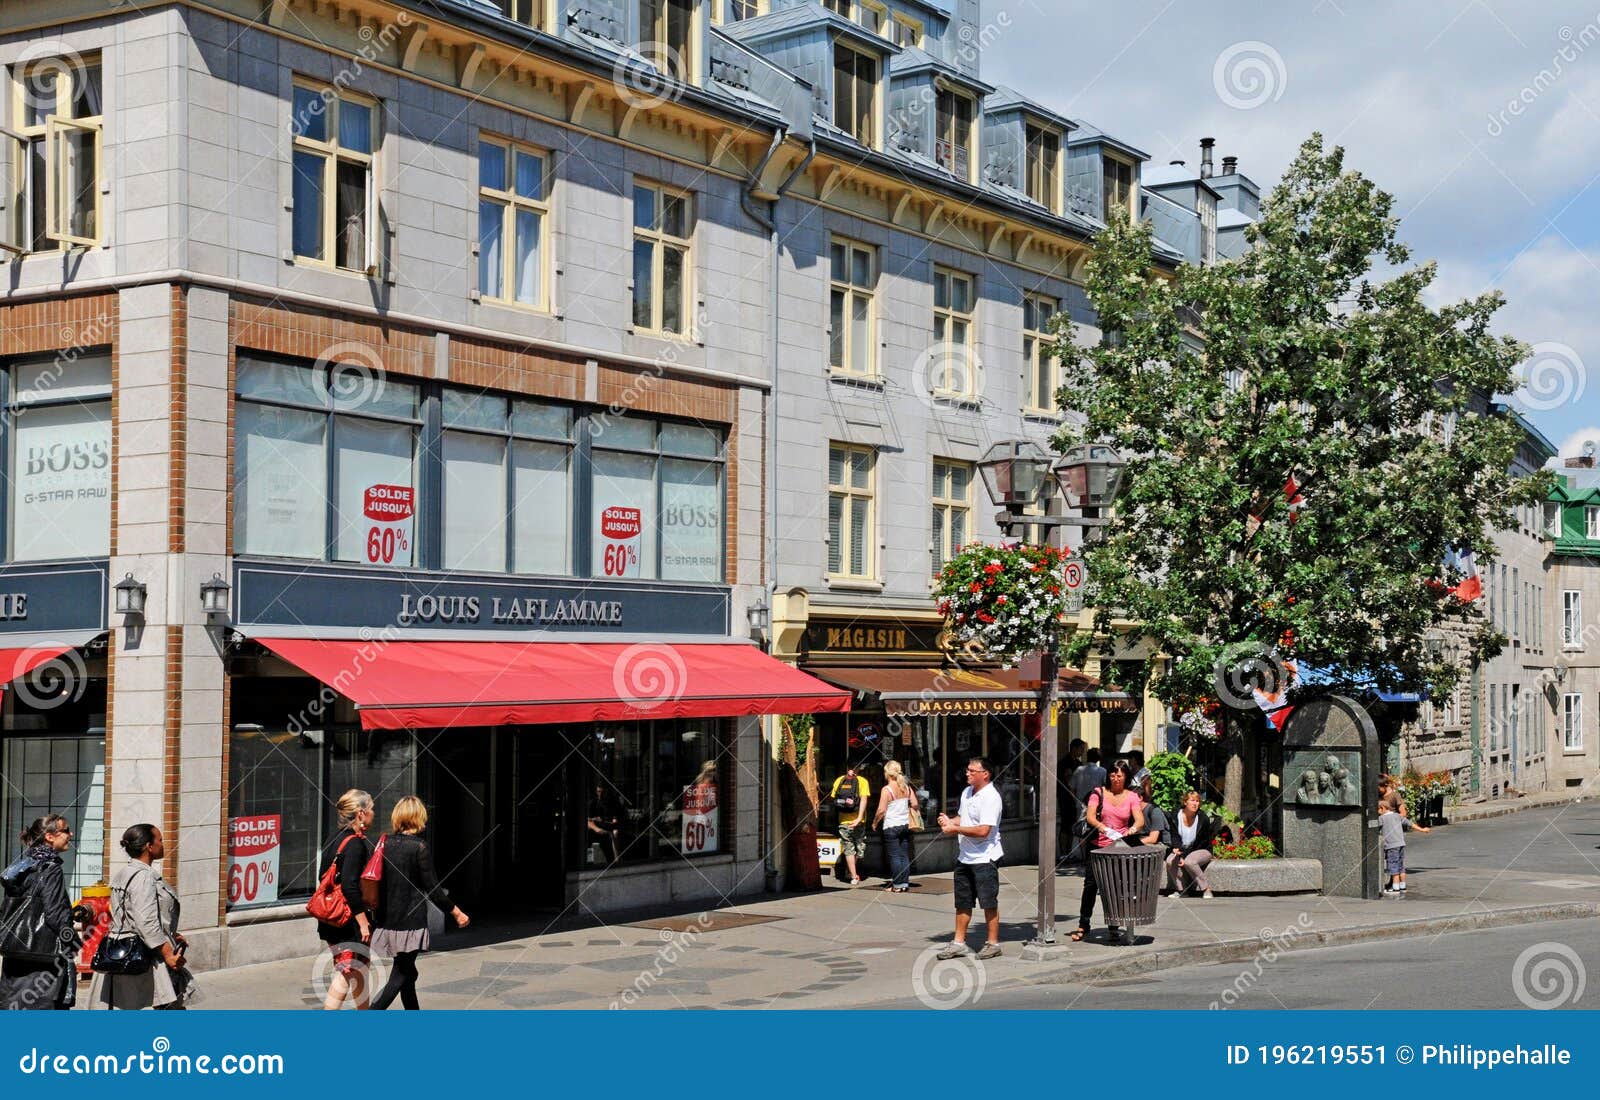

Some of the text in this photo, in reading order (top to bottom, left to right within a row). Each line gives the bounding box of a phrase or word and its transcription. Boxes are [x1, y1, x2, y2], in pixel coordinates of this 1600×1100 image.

[25, 440, 108, 476] BOSS
[24, 488, 107, 504] G-STAR RAW
[368, 487, 410, 500] SOLDE
[368, 501, 412, 515] JUSQU'À
[605, 509, 638, 520] SOLDE
[664, 503, 718, 529] BOSS
[605, 521, 639, 533] JUSQU'À
[367, 526, 408, 564] 60%
[604, 543, 637, 577] 60%
[400, 594, 623, 622] LOUIS LAFLAMME
[827, 628, 906, 649] MAGASIN
[920, 701, 987, 711] MAGASIN
[993, 699, 1038, 710] GÉNÉR
[686, 786, 717, 797] SOLDE
[229, 819, 276, 833] SOLDE
[228, 832, 278, 848] JUSQU'À
[686, 818, 715, 851] 60%
[227, 861, 273, 903] 60%
